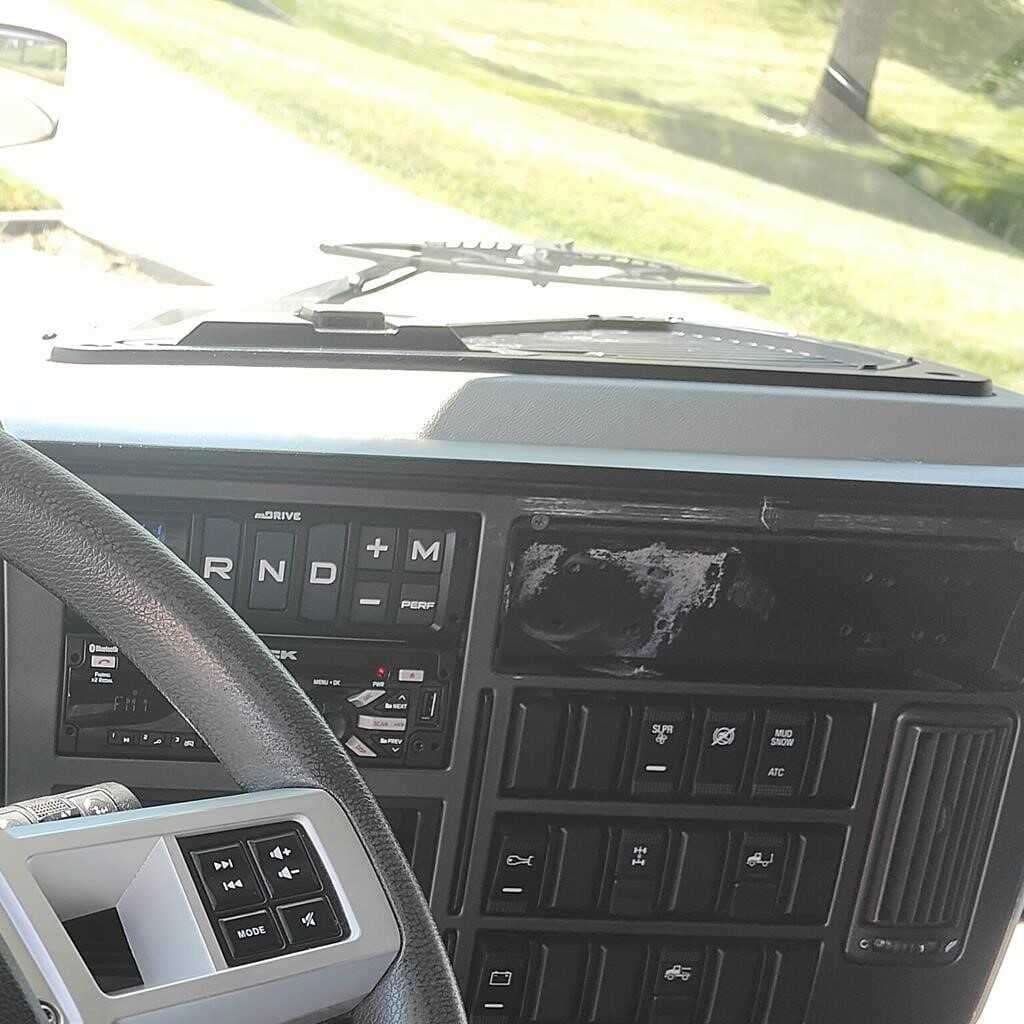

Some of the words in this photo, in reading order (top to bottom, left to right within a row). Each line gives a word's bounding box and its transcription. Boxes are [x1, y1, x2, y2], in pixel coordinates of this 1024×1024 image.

[254, 510, 302, 522] mDRIVE
[410, 540, 441, 562] M
[203, 556, 234, 580] R
[258, 560, 286, 583] N
[309, 561, 338, 585] D
[401, 599, 436, 611] PERF
[651, 724, 674, 735] SLPR
[774, 729, 793, 739] MUD
[770, 737, 795, 747] SNOW
[767, 767, 785, 777] ATC
[237, 925, 267, 939] MODE
